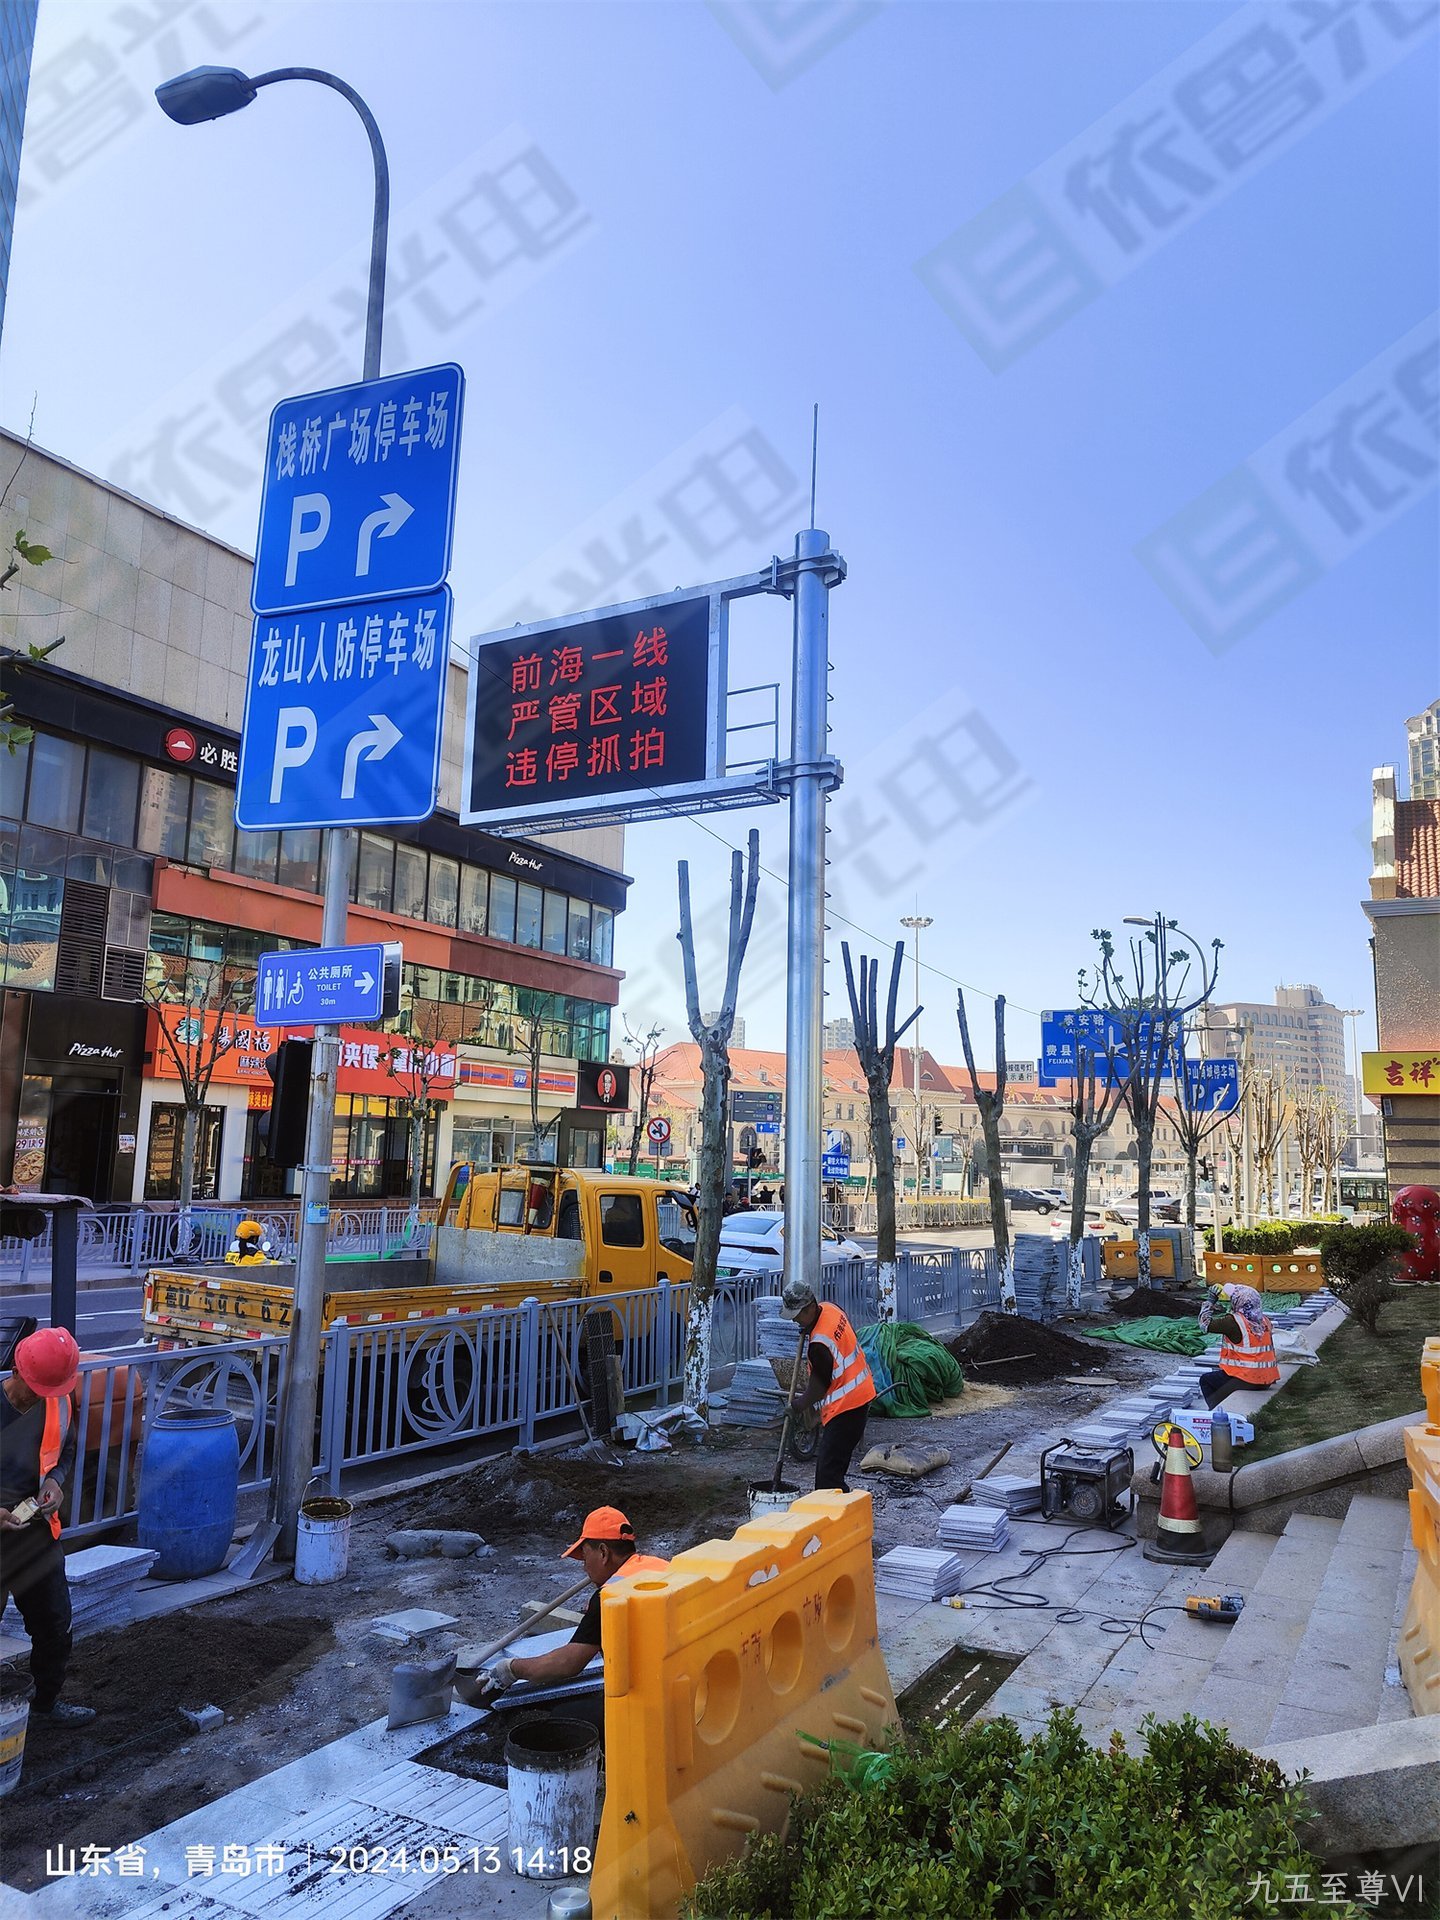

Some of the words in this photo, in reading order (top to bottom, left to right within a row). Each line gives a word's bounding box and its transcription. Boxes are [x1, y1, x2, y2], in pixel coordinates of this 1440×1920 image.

[276, 391, 449, 481] 栈桥广场停车场
[285, 493, 331, 587] P
[258, 608, 436, 687] 龙山人防停车场
[511, 626, 668, 693] 前海一线
[507, 677, 668, 740] 严管区域
[200, 742, 238, 772] 必胜
[269, 706, 318, 804] P
[504, 727, 665, 788] 违停抓拍
[508, 851, 529, 866] Pizza
[528, 858, 544, 871] Hut
[307, 964, 353, 981] 公共厕所
[316, 982, 341, 992] TOILET
[320, 998, 336, 1006] 30m
[1063, 1014, 1105, 1026] 泰安路
[68, 1042, 100, 1057] Pizza
[100, 1045, 124, 1059] Hut
[1005, 1064, 1032, 1072] 按信号灯
[1384, 1058, 1440, 1089] 吉祥
